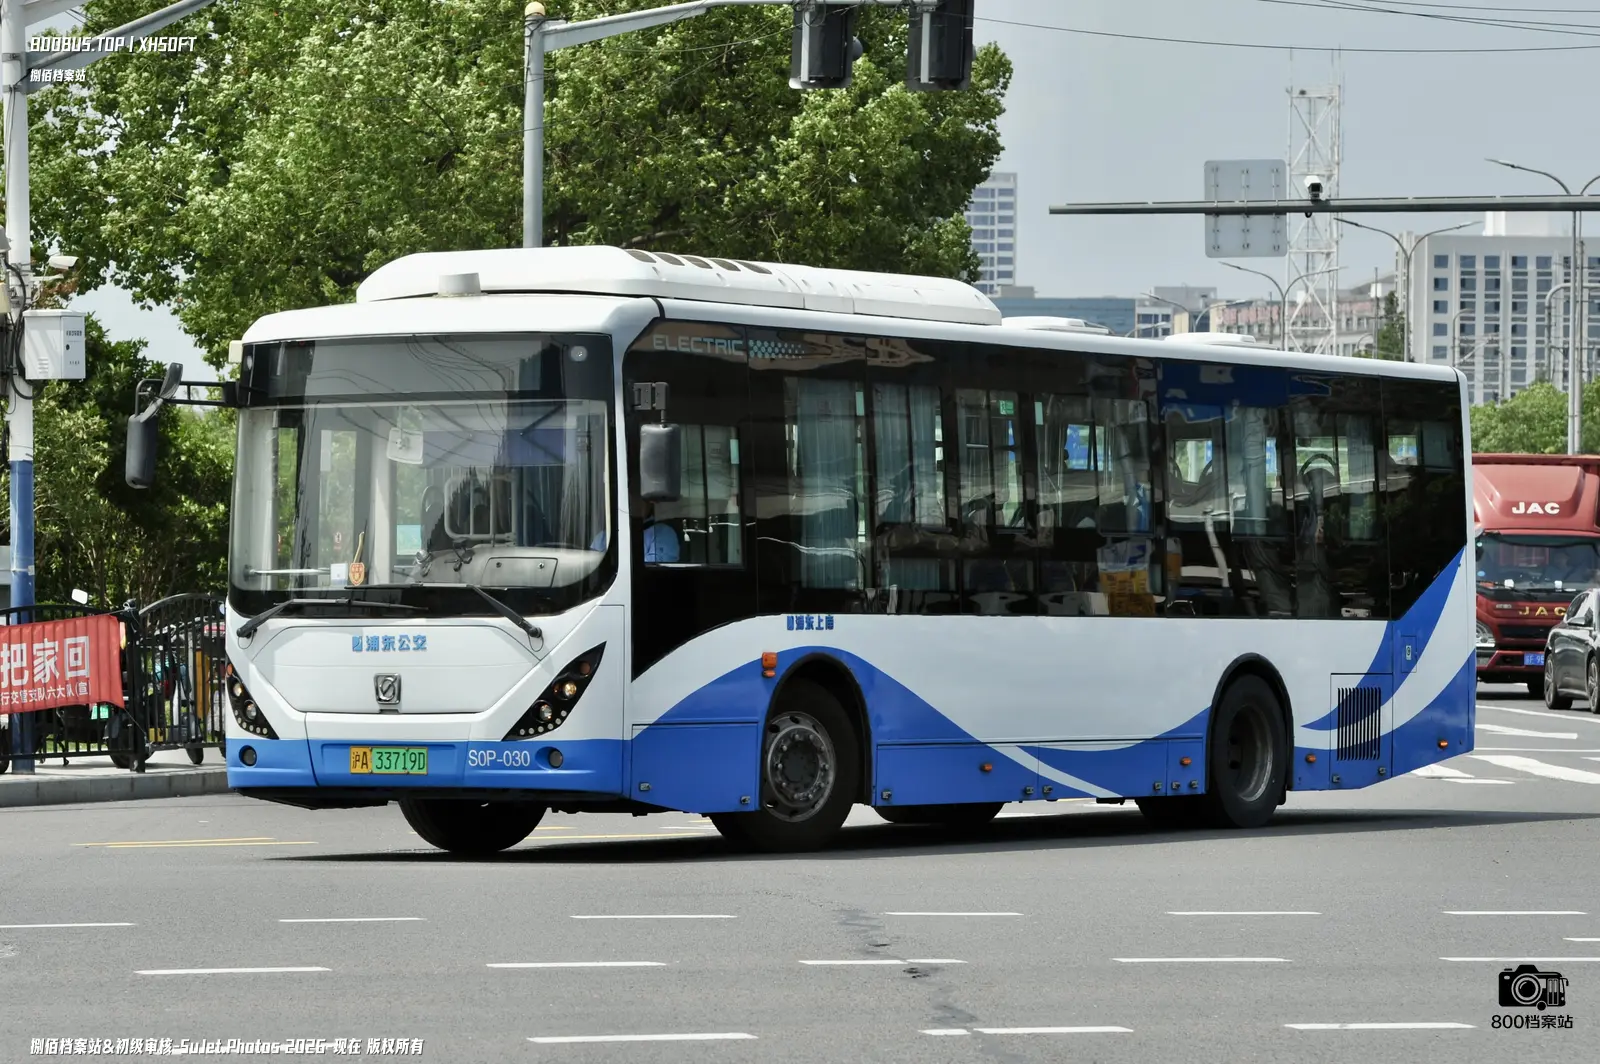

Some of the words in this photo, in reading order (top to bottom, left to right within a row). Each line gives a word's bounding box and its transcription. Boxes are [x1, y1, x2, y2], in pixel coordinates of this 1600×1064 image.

[653, 334, 744, 356] ELECTRIC
[1512, 501, 1560, 515] JAC
[366, 635, 427, 652] 浦东公交
[0, 636, 90, 688] 把家回
